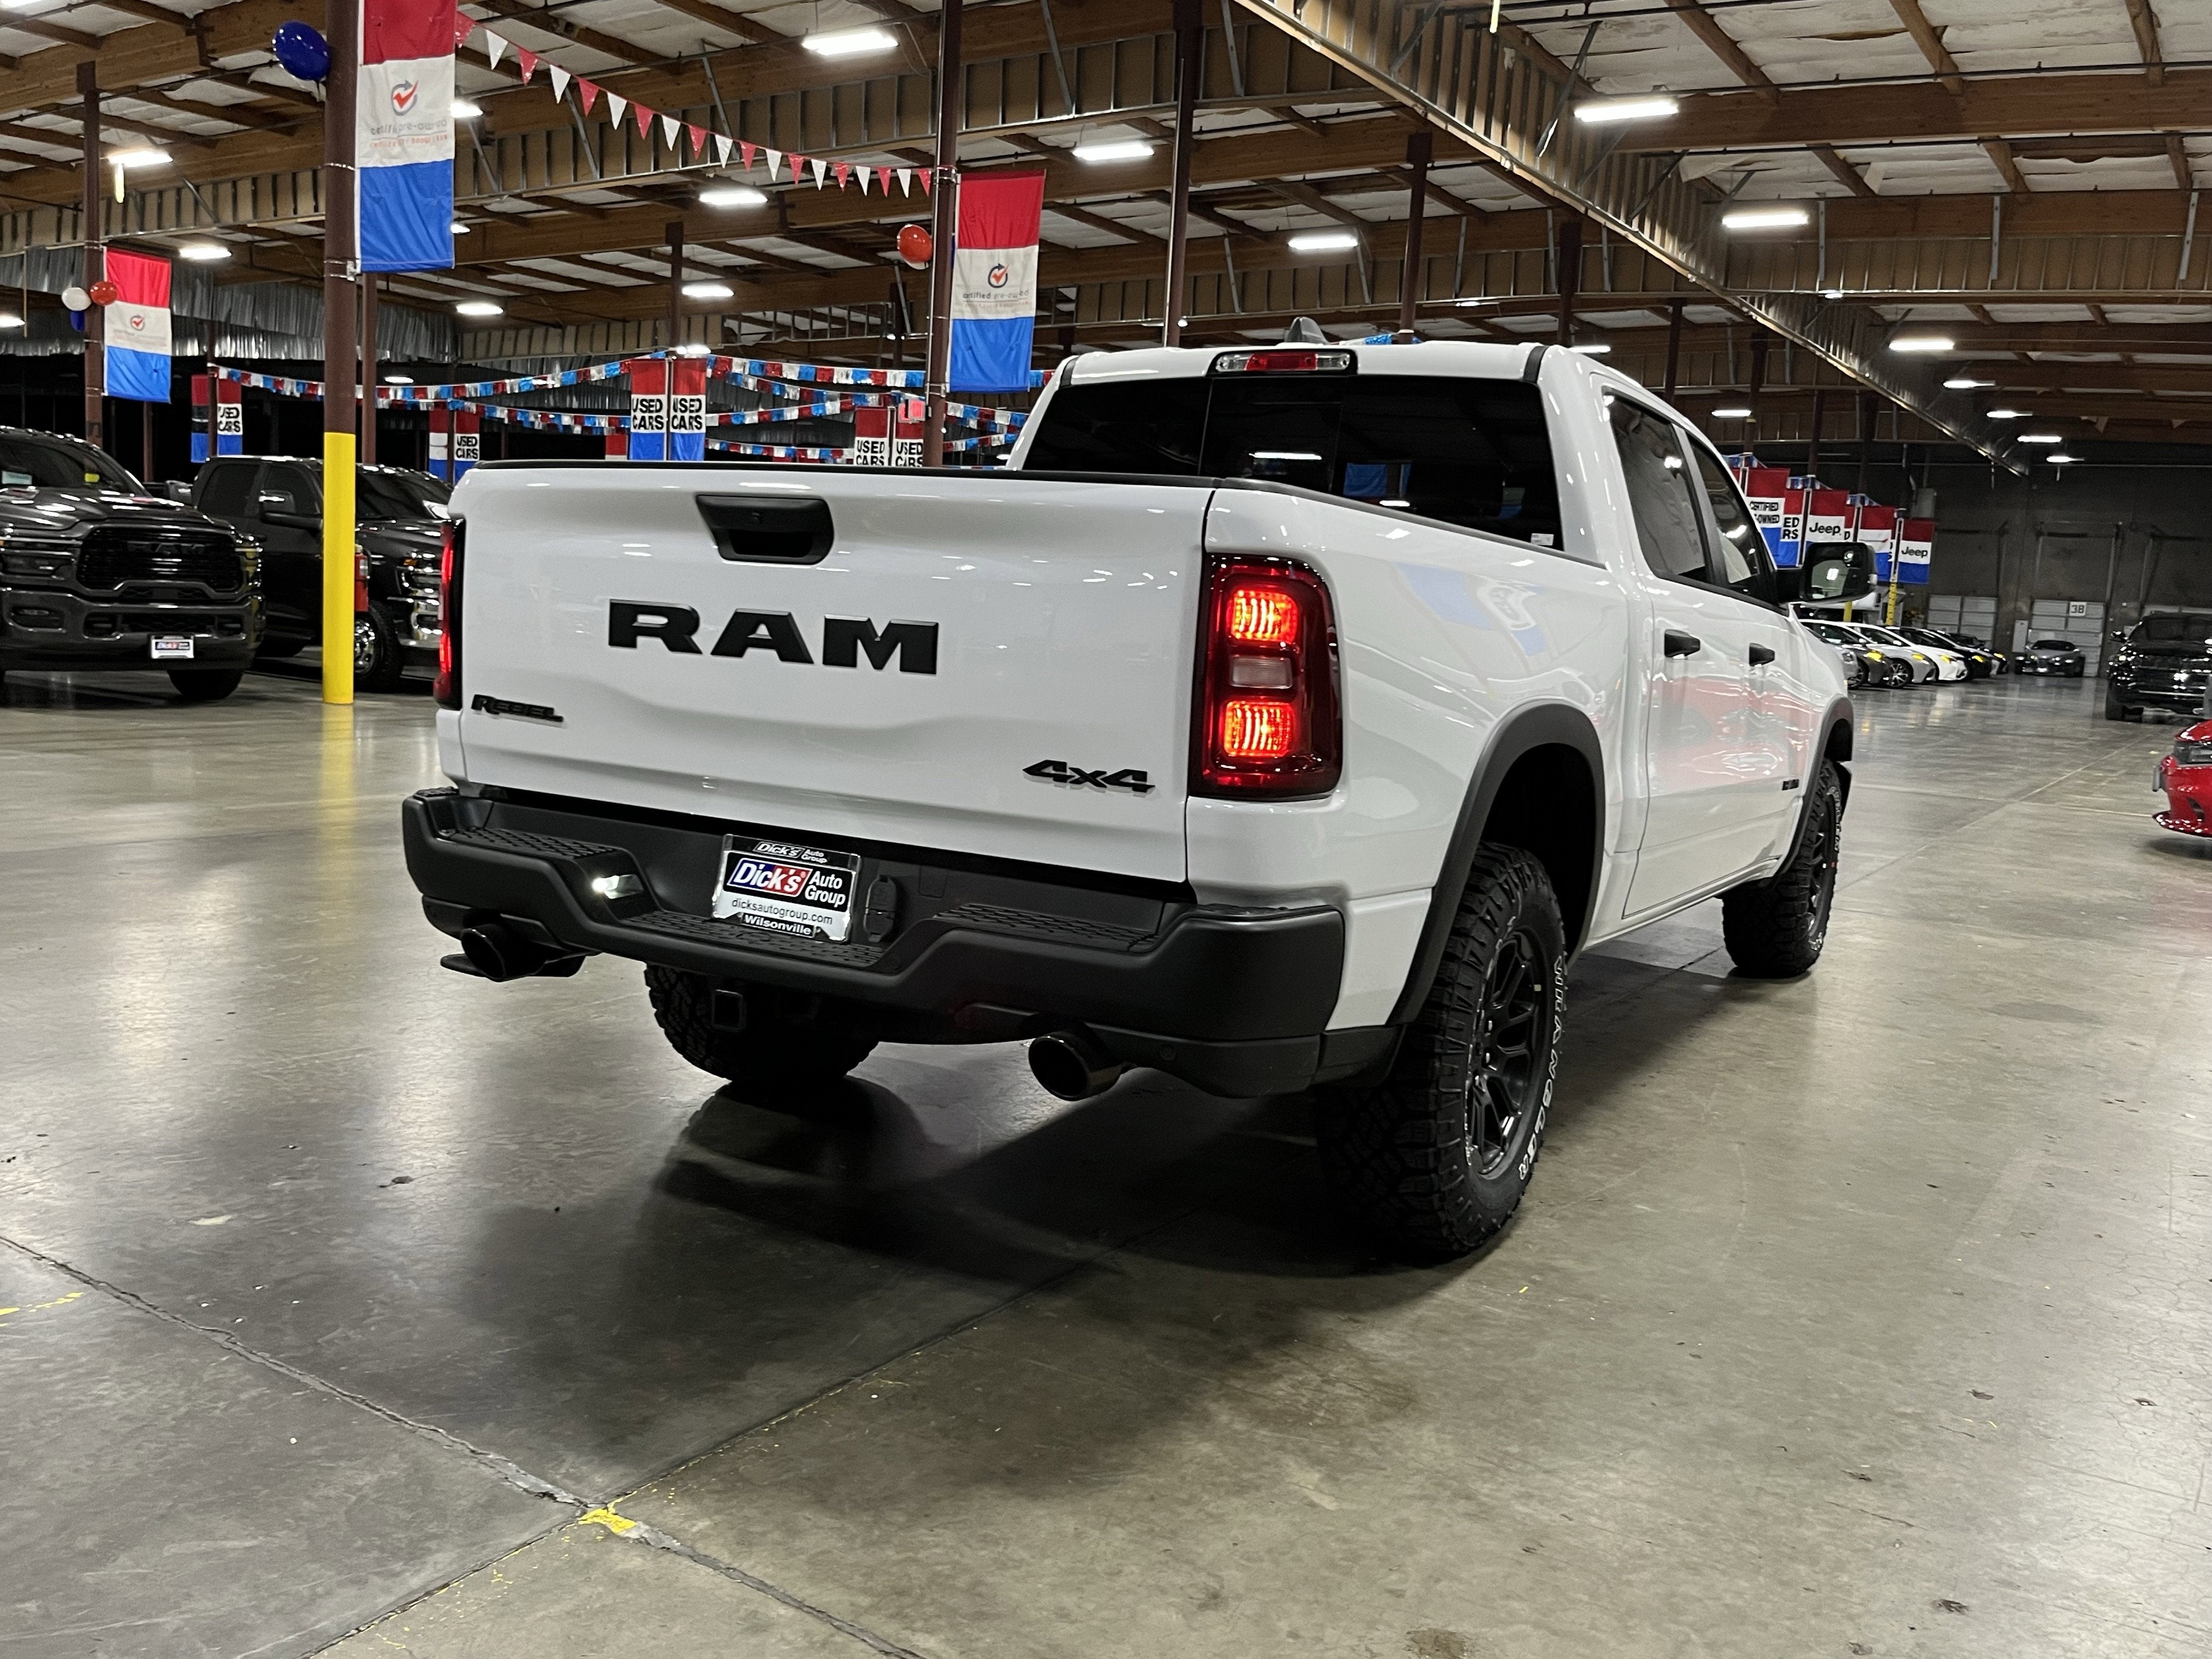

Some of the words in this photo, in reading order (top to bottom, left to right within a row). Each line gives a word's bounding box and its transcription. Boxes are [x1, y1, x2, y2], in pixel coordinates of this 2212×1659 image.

[632, 398, 663, 414] USED
[673, 398, 703, 413] USED
[632, 415, 664, 430] CARS
[672, 415, 703, 430] CARS
[857, 440, 885, 454] USED
[896, 441, 923, 455] USED
[1809, 522, 1841, 535] Jeep
[1901, 546, 1928, 558] Jeep
[608, 599, 939, 675] RAM
[757, 843, 800, 856] Dick's
[801, 854, 827, 864] Group
[733, 862, 803, 893] Dick's
[809, 871, 843, 889] Auto
[804, 885, 846, 908] Group
[731, 898, 833, 925] dicksautogroup.com
[744, 914, 812, 935] Wilsonville
